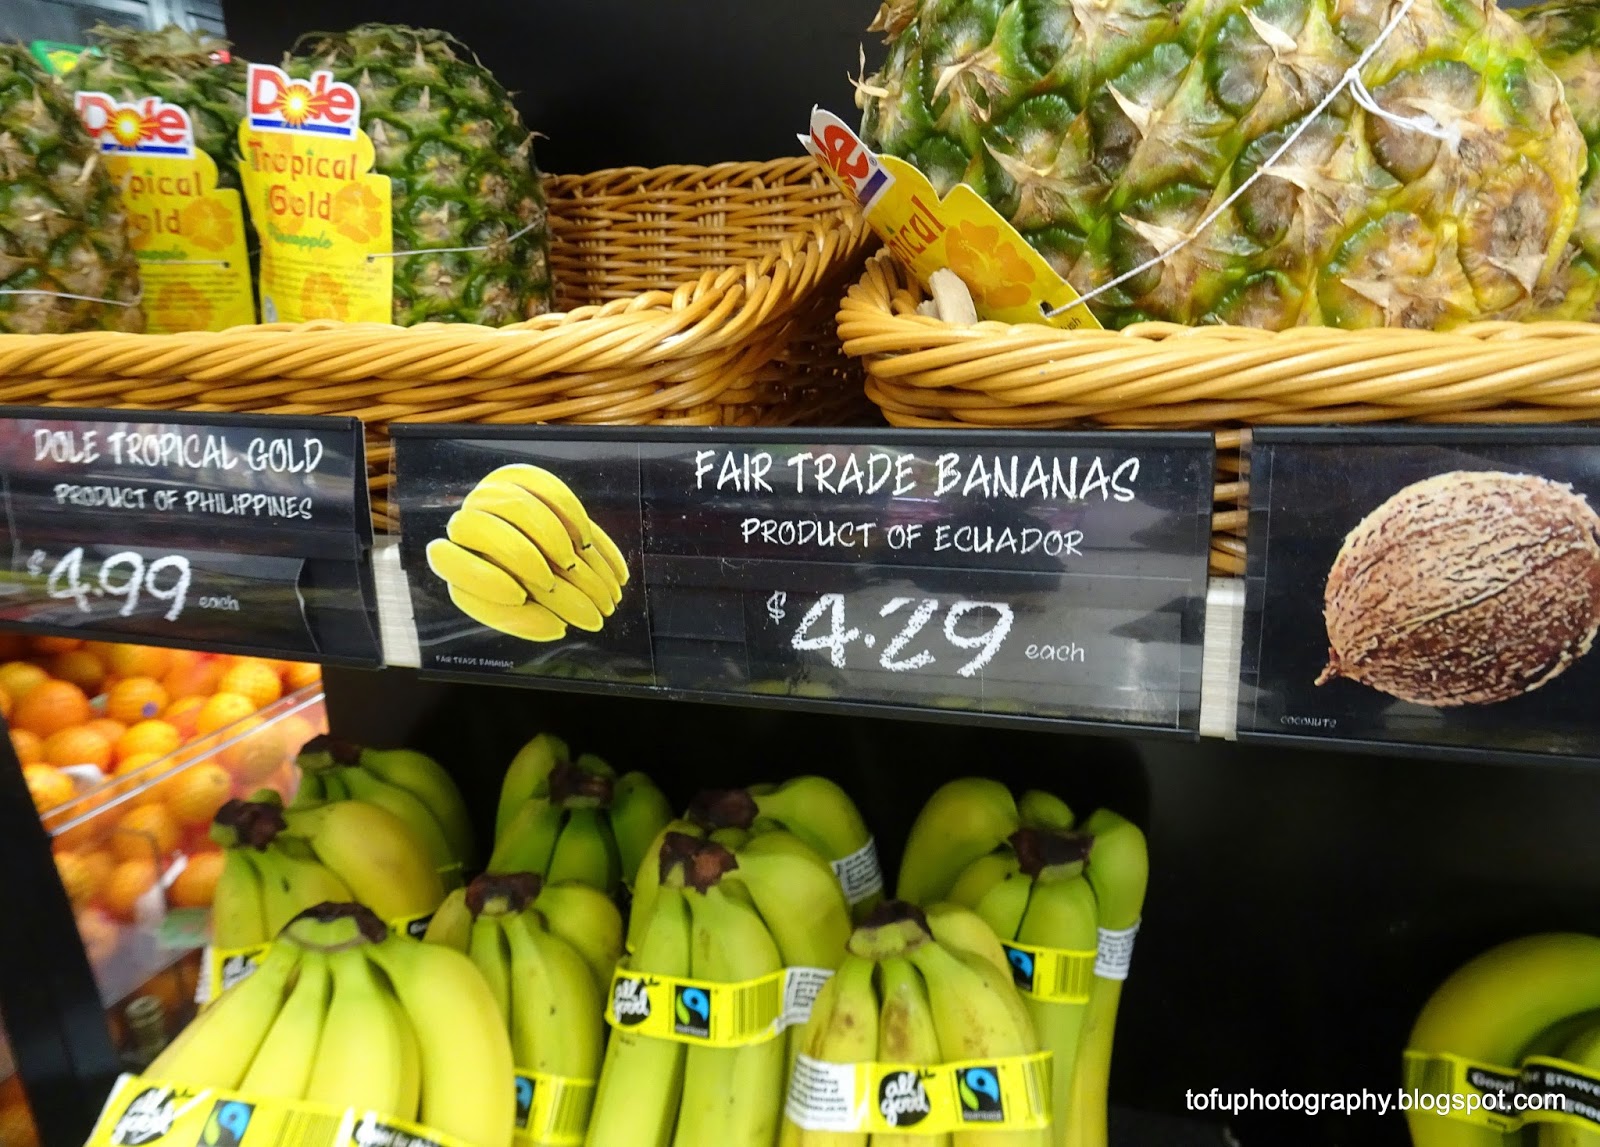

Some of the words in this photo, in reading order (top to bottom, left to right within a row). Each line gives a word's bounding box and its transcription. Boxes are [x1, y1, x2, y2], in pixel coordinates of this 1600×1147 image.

[252, 69, 355, 123] Dole
[79, 96, 187, 144] Dole
[247, 140, 358, 181] Tropical
[811, 125, 869, 190] le
[129, 171, 203, 200] pical
[268, 184, 331, 220] Gold
[131, 207, 181, 235] old
[889, 194, 946, 273] pical
[34, 428, 100, 463] DOLE
[106, 431, 239, 470] TROPICAL
[247, 437, 323, 473] GOLD
[694, 449, 773, 494] FAIR
[787, 452, 916, 496] TRADE
[934, 452, 1141, 502] BANANAS
[53, 483, 148, 510] PRODUCT
[153, 489, 179, 511] OF
[184, 490, 313, 519] PHILIPPINES
[741, 517, 877, 549] PRODUCT
[887, 523, 923, 550] OF
[934, 525, 1085, 556] ECUADOR
[199, 595, 241, 612] each
[1024, 642, 1086, 663] each
[1280, 715, 1337, 728] COCONUTS
